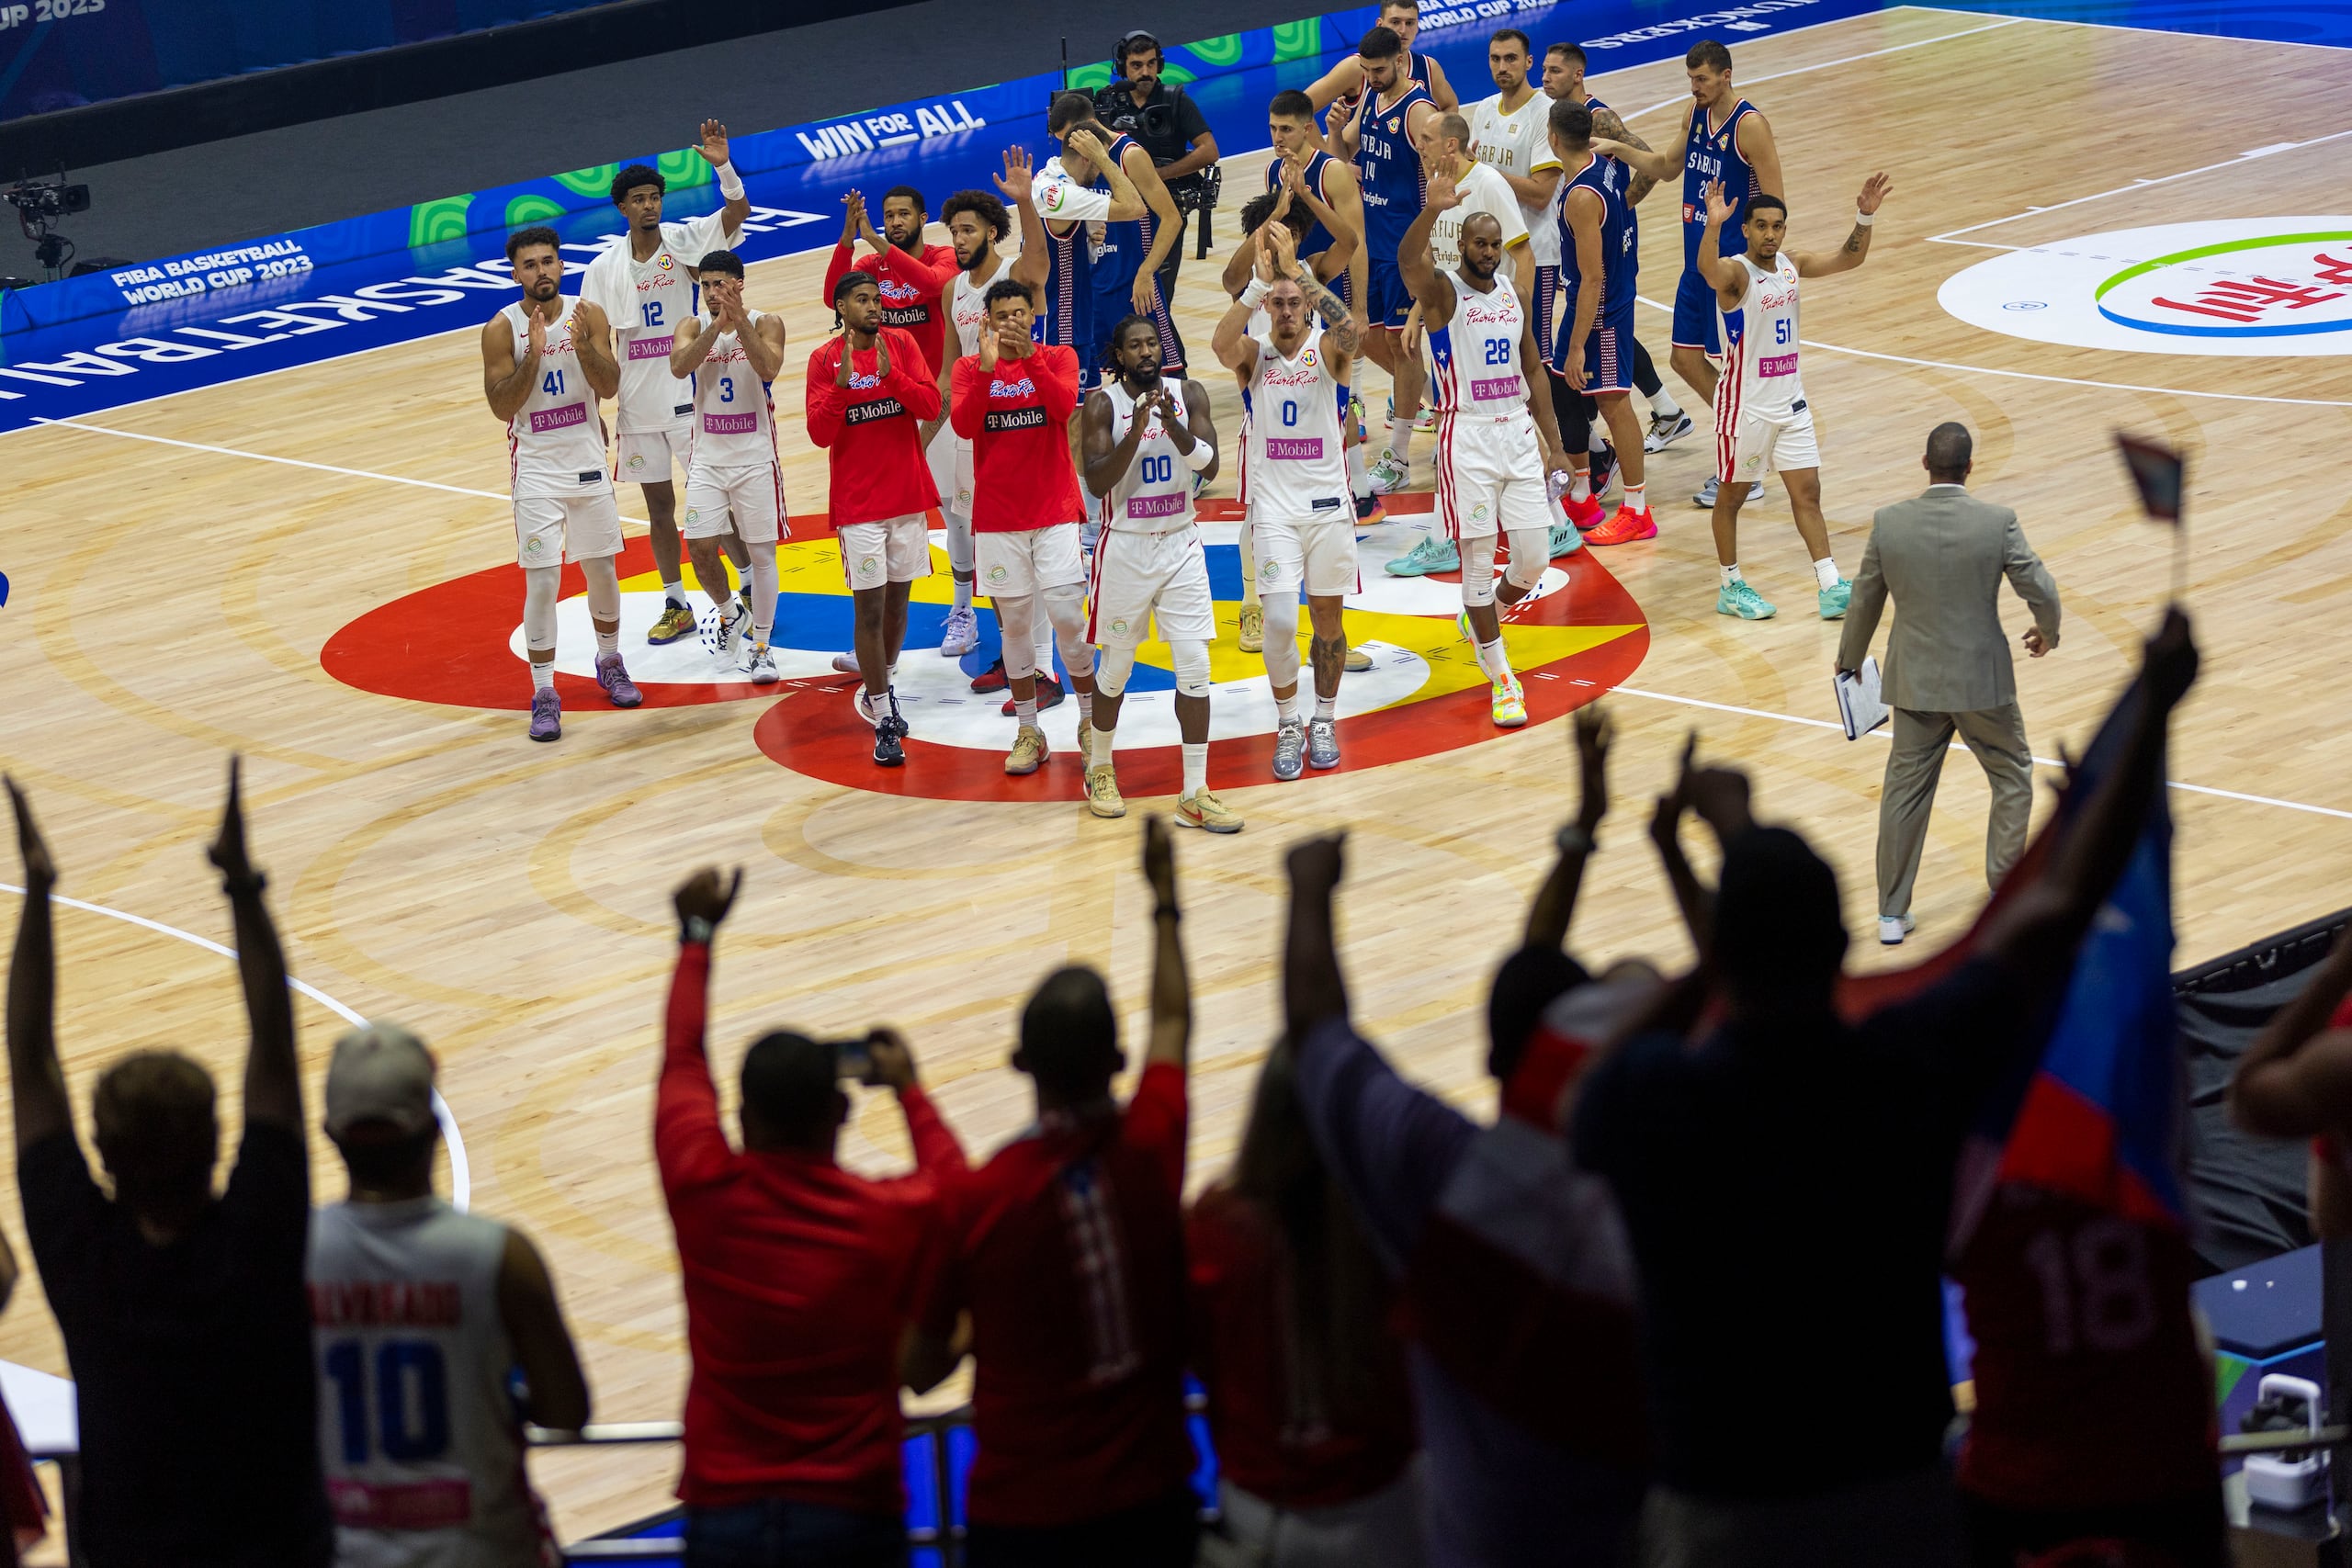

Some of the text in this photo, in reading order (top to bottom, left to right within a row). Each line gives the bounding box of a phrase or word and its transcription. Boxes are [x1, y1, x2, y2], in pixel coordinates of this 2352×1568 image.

[1418, 7, 1477, 30] WORLD
[1476, 1, 1512, 17] CUP
[796, 100, 987, 162] WIN FOR ALL
[1365, 161, 1375, 181] 14
[1363, 191, 1388, 207] triglav
[1695, 210, 1708, 226] trig
[1097, 243, 1118, 257] glav
[110, 239, 303, 288] FIBA BASKETBALL
[122, 254, 314, 306] WORLD CUP 2023
[642, 301, 664, 327] 12
[888, 309, 926, 324] Mobile
[1776, 318, 1791, 344] 51
[641, 340, 673, 355] Mobil
[1485, 338, 1510, 366] 28
[1774, 356, 1796, 373] Mobil
[542, 369, 565, 396] 41
[1264, 369, 1295, 386] Puerto
[720, 378, 734, 402] 3
[547, 408, 583, 426] Mobile
[861, 400, 901, 419] Mobile
[1000, 411, 1043, 428] Mobile
[1283, 400, 1297, 426] 0
[715, 416, 754, 431] Mobile
[1277, 442, 1318, 456] Mobile
[1142, 455, 1171, 484] 00
[1146, 498, 1182, 514] Mobile
[2026, 1217, 2158, 1355] 18
[326, 1338, 448, 1464] 10
